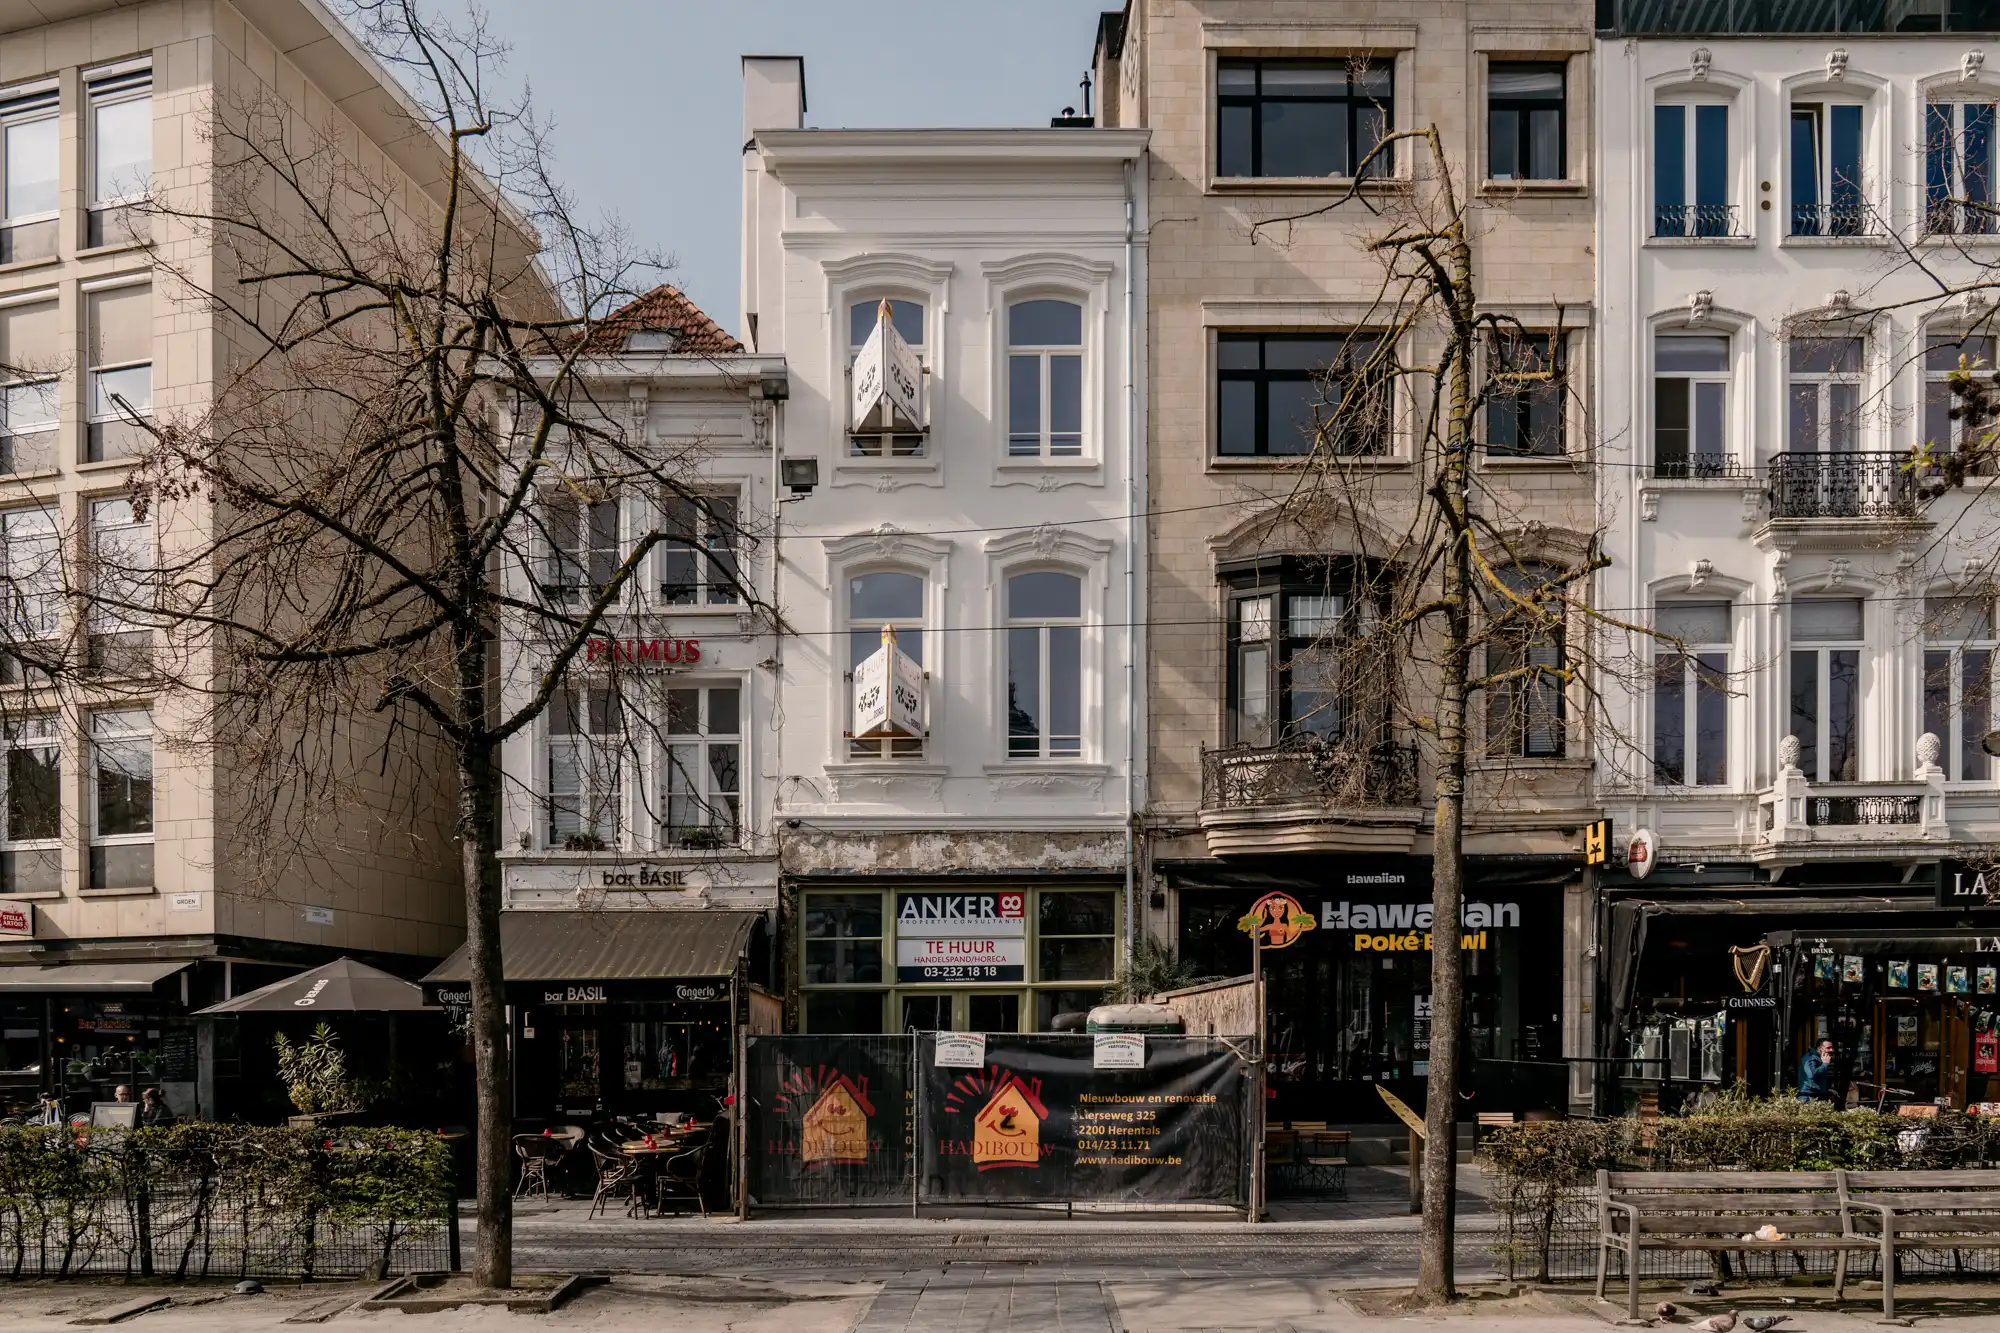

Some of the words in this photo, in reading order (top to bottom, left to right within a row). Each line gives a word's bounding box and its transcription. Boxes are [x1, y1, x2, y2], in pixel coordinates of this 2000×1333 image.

[603, 870, 635, 886] bar
[640, 870, 686, 886] BASIL
[1346, 872, 1406, 885] Hawaiian
[1953, 872, 1990, 896] LA
[900, 896, 997, 918] ANKER
[1001, 895, 1022, 918] 18
[2, 913, 23, 921] STELLA
[925, 941, 944, 954] TE
[948, 940, 996, 954] HUUR
[1354, 929, 1420, 952] Poké
[913, 954, 1007, 964] HANDELSPAND/HORECA
[923, 966, 964, 977] 03-232
[966, 966, 981, 977] 18
[983, 966, 998, 977] 18
[436, 988, 472, 1004] Tongerl
[544, 991, 564, 1002] bar
[567, 987, 607, 1001] BASIL
[675, 985, 715, 1001] Tongerlo
[1729, 997, 1776, 1008] GUINNESS
[1079, 1093, 1145, 1104] Nieuwbouw
[1147, 1095, 1162, 1104] en
[1164, 1093, 1218, 1104] renovatie
[1136, 1110, 1157, 1121] 325
[1079, 1125, 1106, 1136] 2200
[1107, 1124, 1161, 1136] Herentals
[939, 1139, 1056, 1157] HADIBOUW
[1078, 1139, 1151, 1151] 014/23.11.71
[1078, 1154, 1182, 1166] www.hadibouw.be
